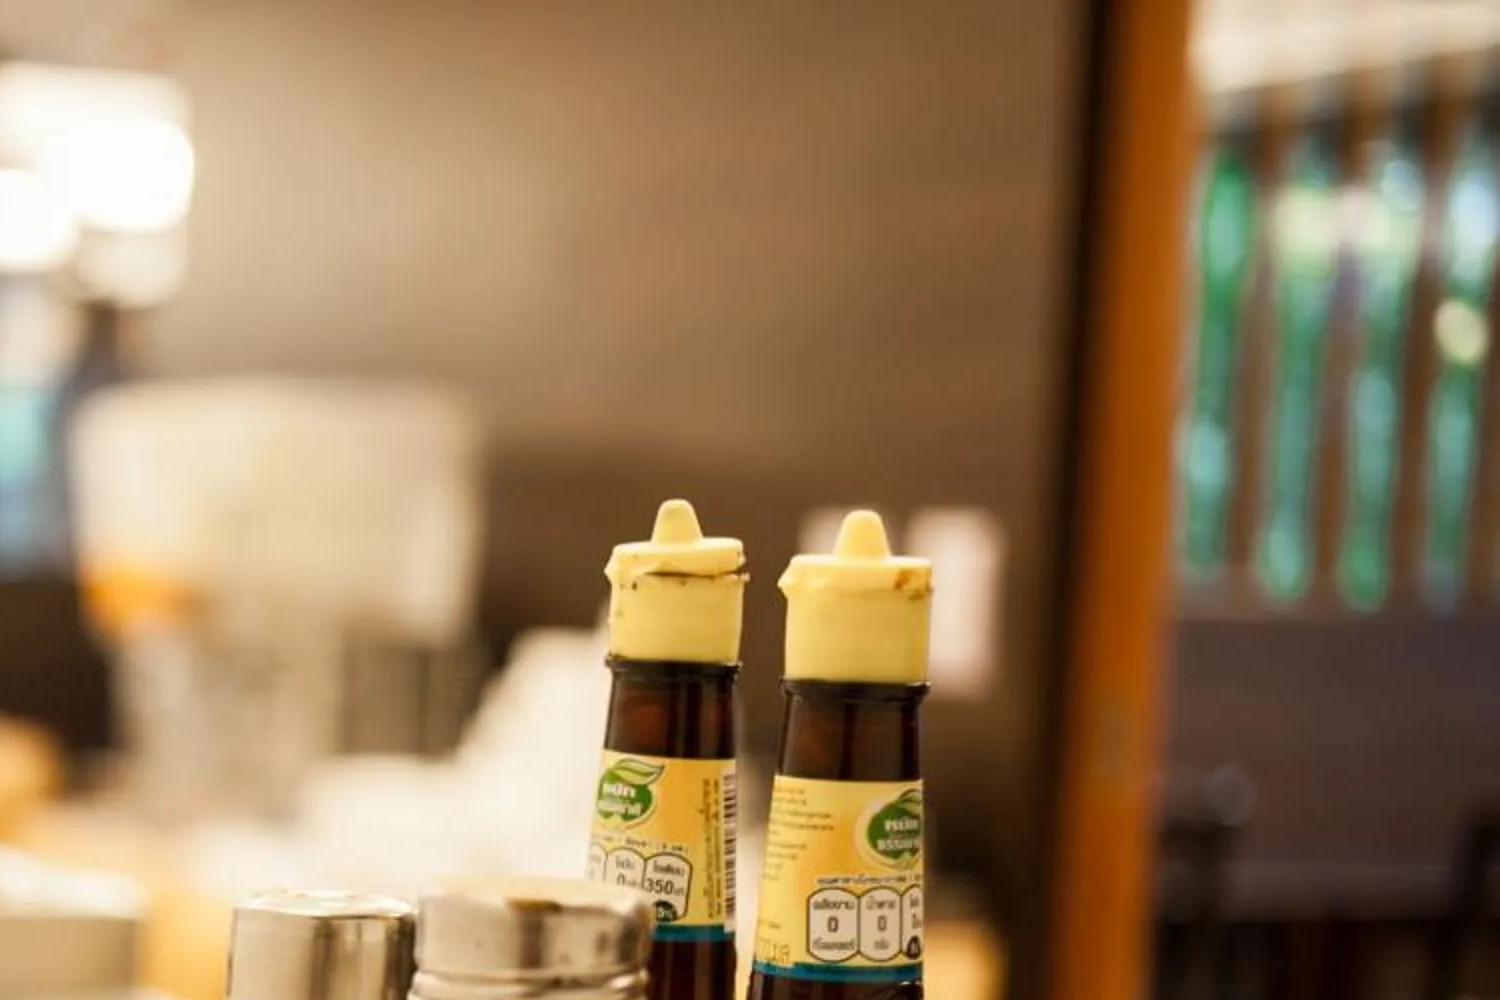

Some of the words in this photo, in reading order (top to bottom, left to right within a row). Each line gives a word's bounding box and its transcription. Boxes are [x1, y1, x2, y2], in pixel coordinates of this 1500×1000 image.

[646, 877, 675, 895] 350
[827, 916, 839, 932] 0
[877, 915, 888, 932] 0
